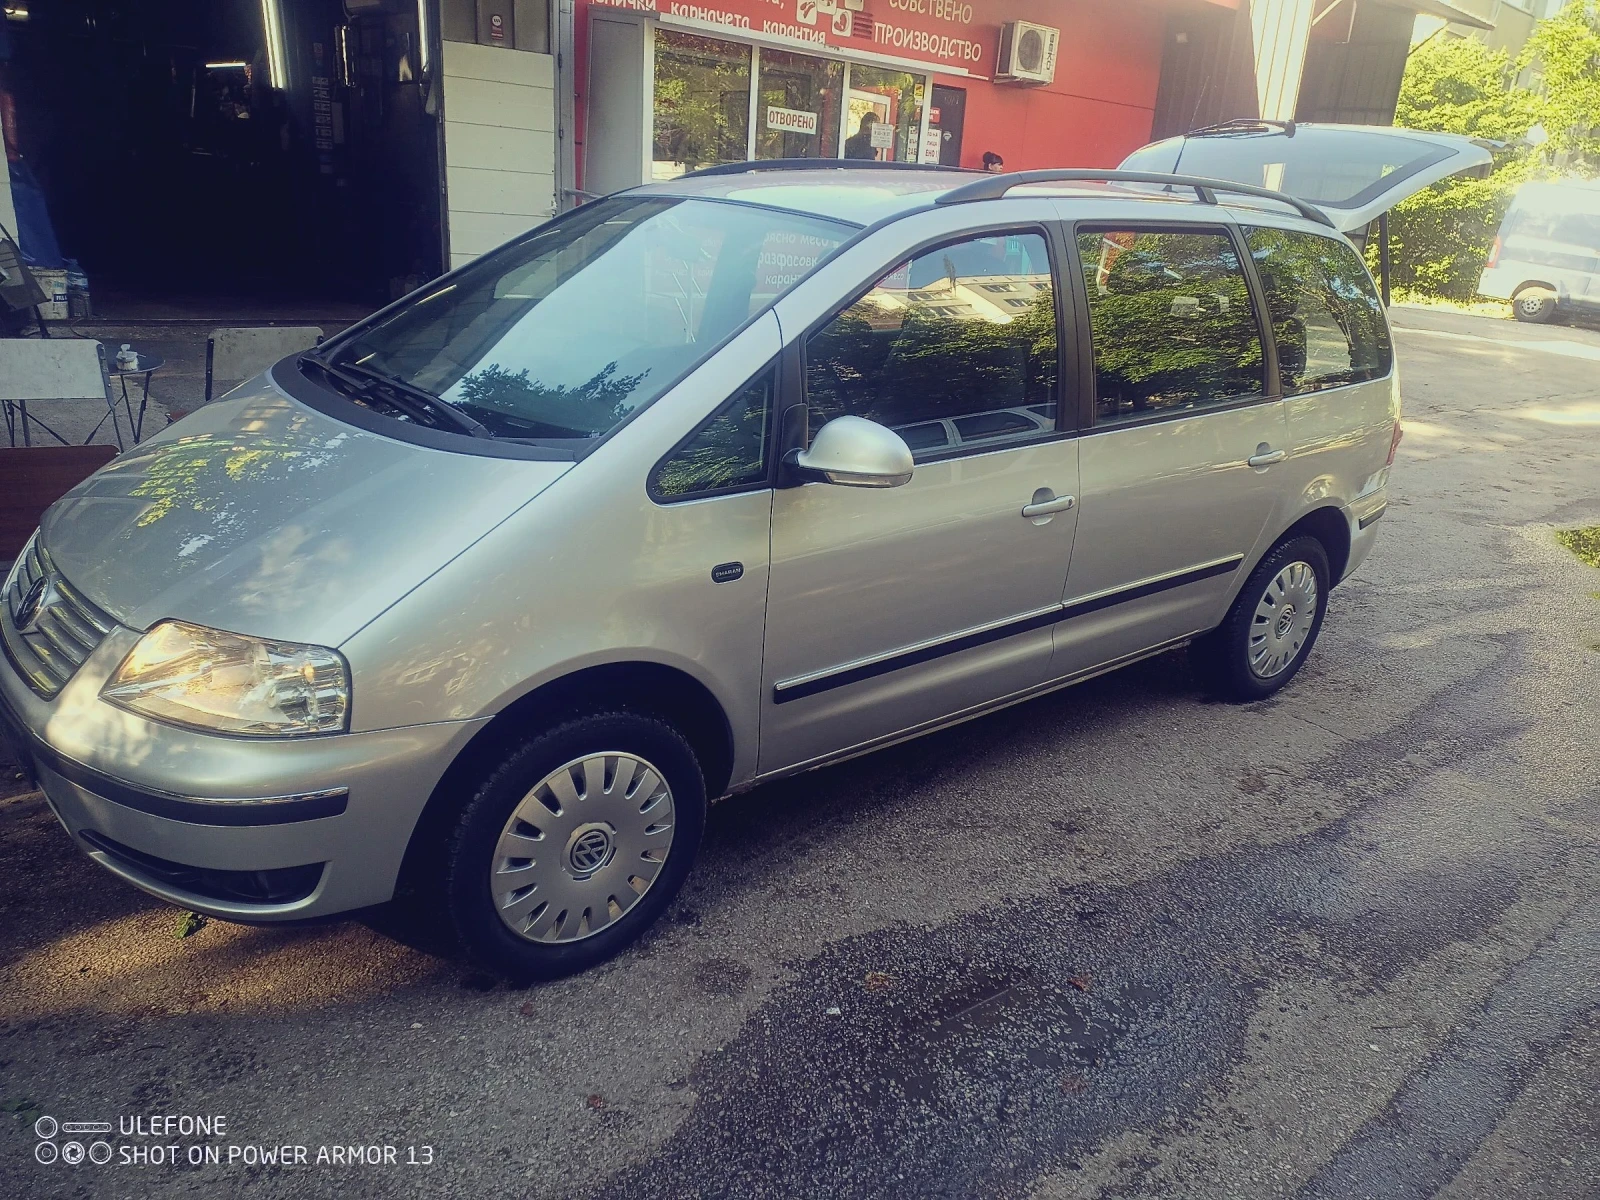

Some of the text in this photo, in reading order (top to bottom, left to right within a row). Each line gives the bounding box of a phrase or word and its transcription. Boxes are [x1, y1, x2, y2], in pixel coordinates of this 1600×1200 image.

[874, 22, 982, 62] ПРОИЗВОДСТВО
[768, 110, 815, 130] ОТВОРЕНО
[715, 566, 742, 578] SHARAN
